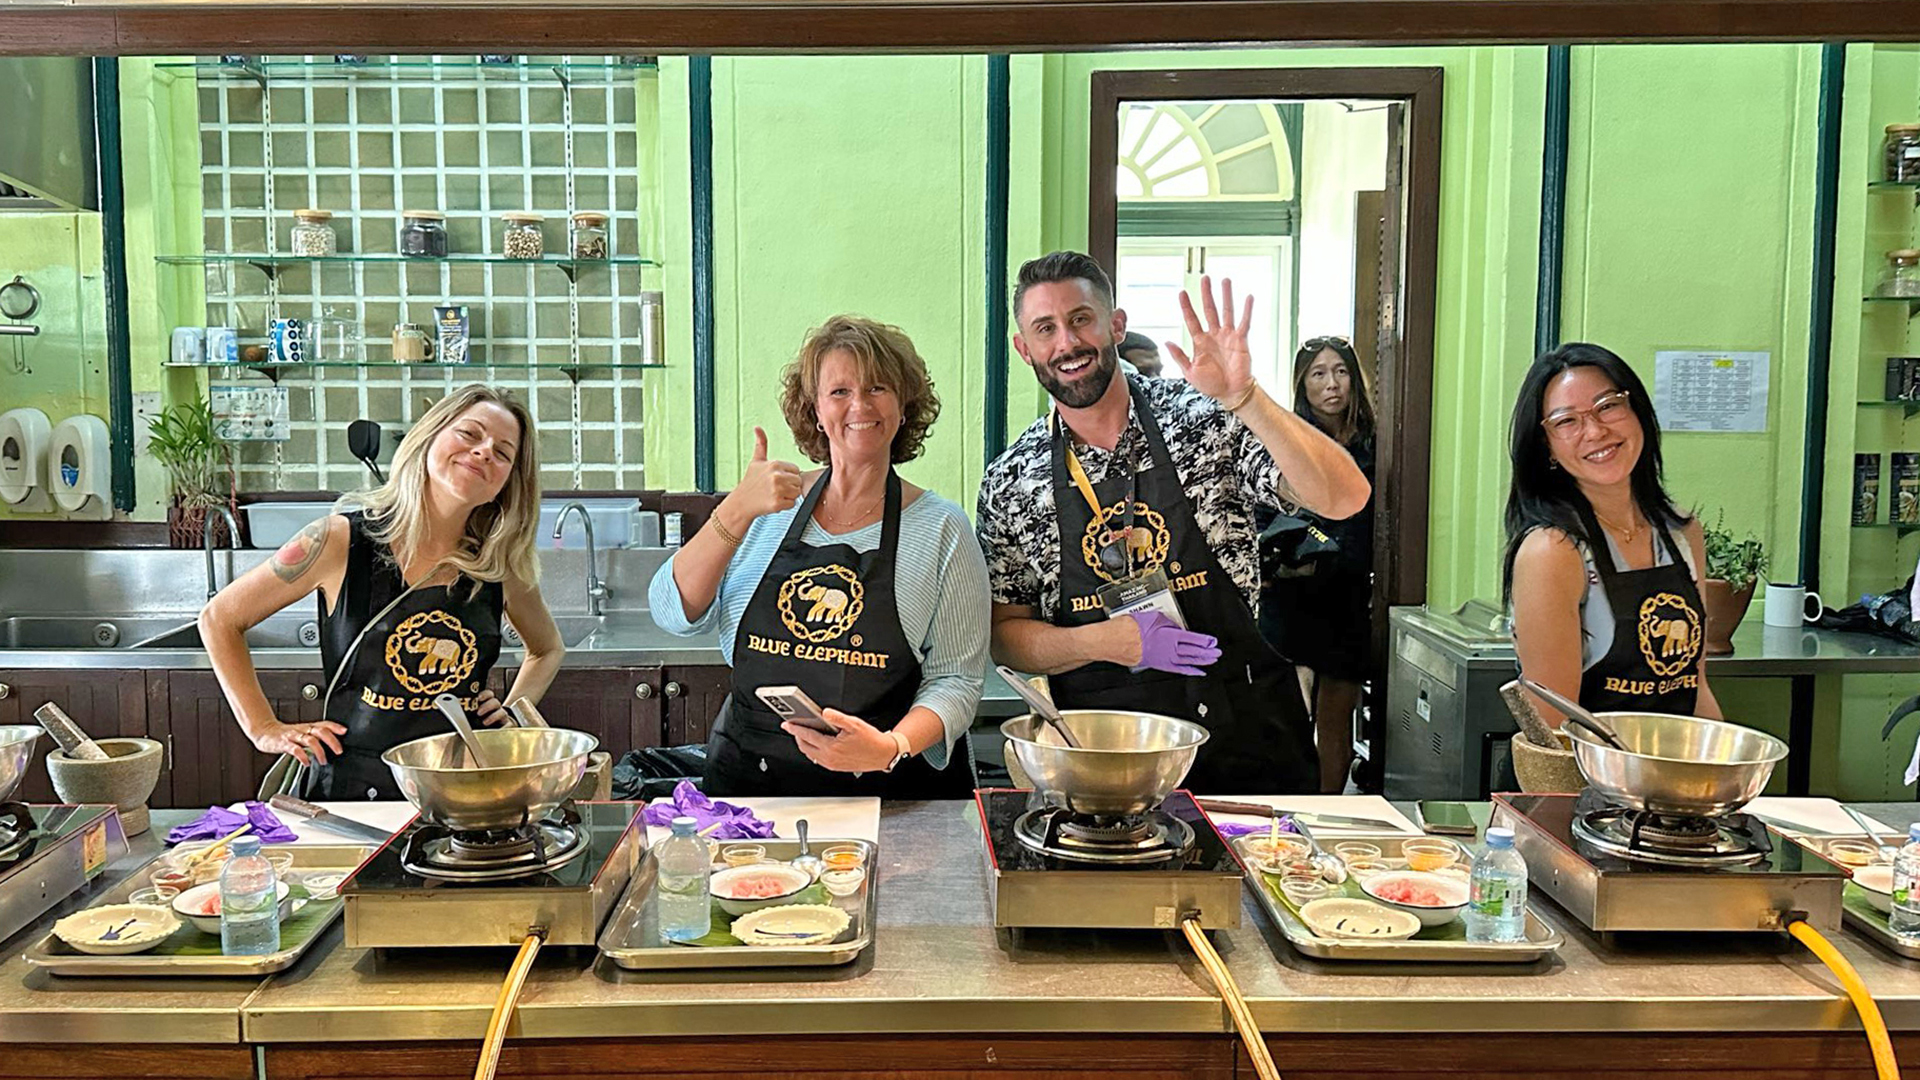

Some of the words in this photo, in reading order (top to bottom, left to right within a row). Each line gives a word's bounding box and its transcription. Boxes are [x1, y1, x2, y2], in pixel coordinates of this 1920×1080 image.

[1070, 594, 1103, 612] BLU
[748, 635, 790, 656] BLUE
[794, 644, 889, 668] ELEPHANT
[1604, 677, 1655, 695] BLUE
[1658, 675, 1698, 694] ELEPH
[361, 686, 405, 710] BLUE
